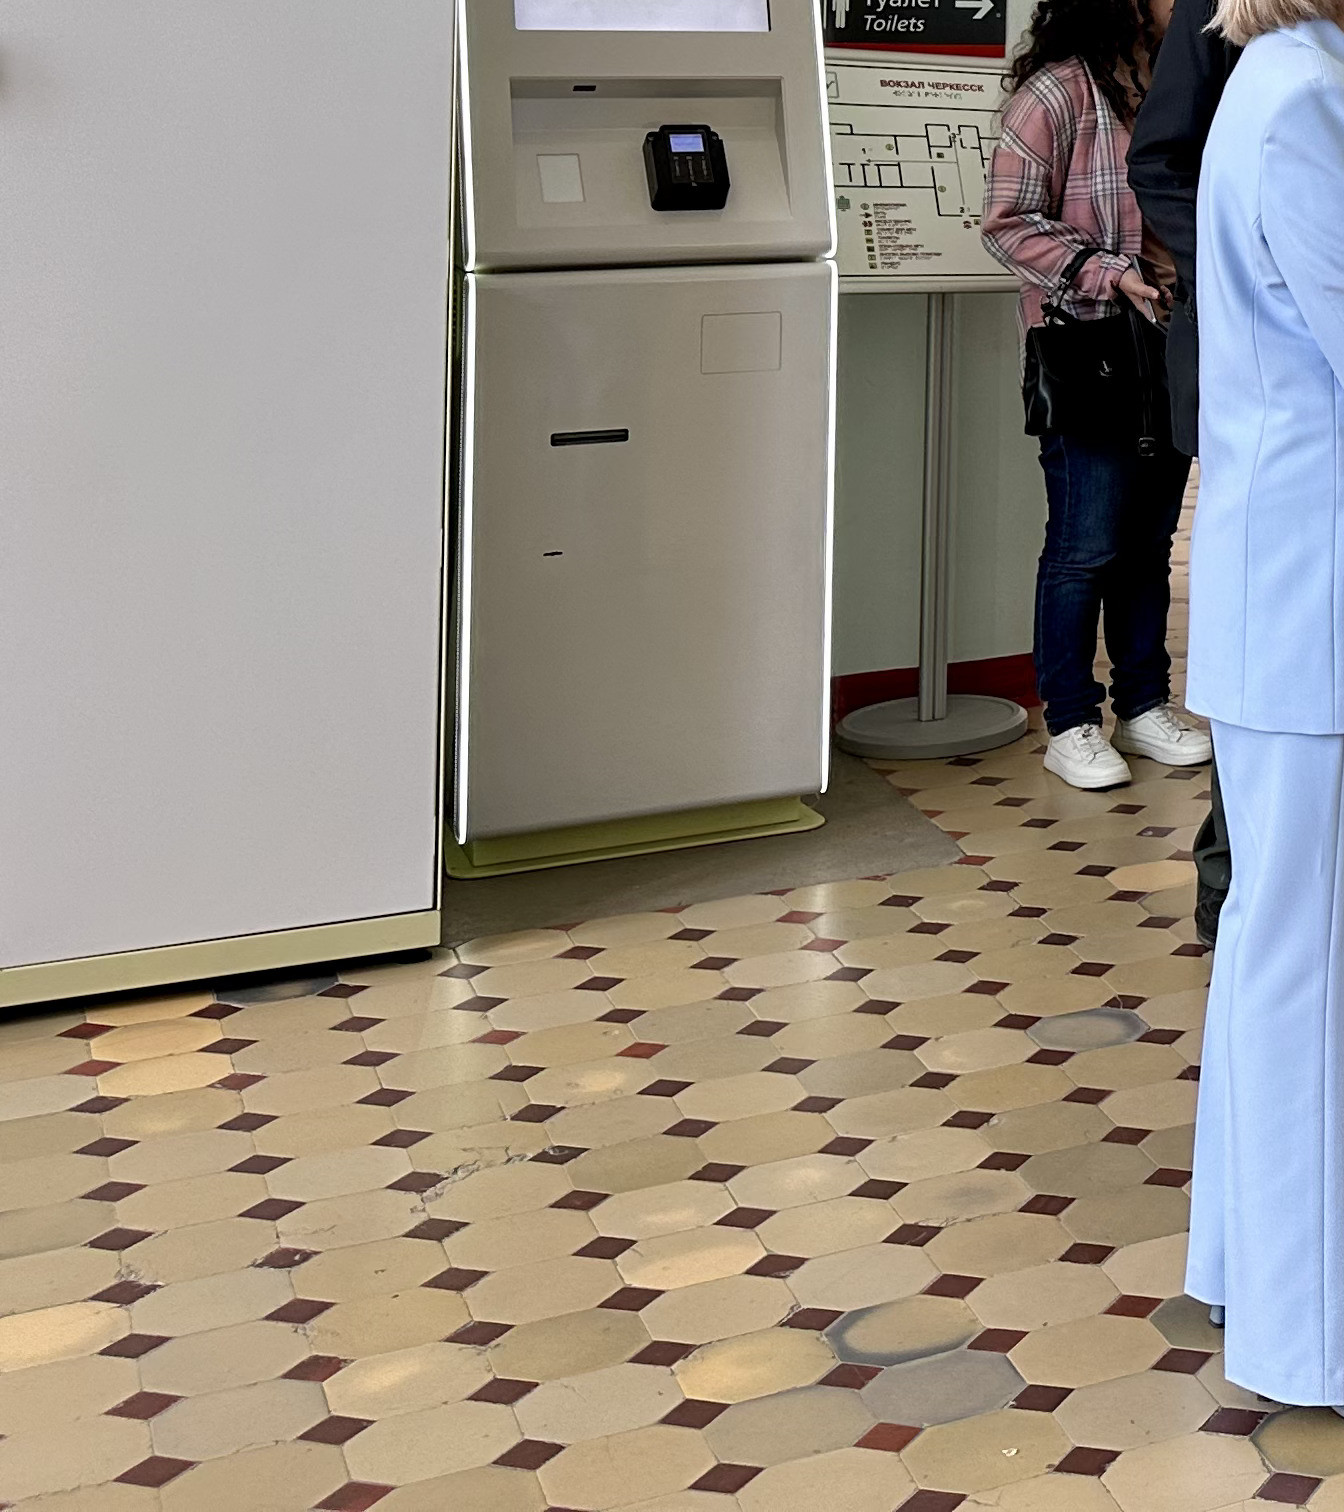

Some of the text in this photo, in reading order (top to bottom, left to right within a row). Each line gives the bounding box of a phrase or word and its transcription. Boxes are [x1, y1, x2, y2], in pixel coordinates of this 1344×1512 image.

[863, 14, 926, 32] Toilets
[879, 79, 985, 93] ВОКЗАЛ ЧЕРКЕССК
